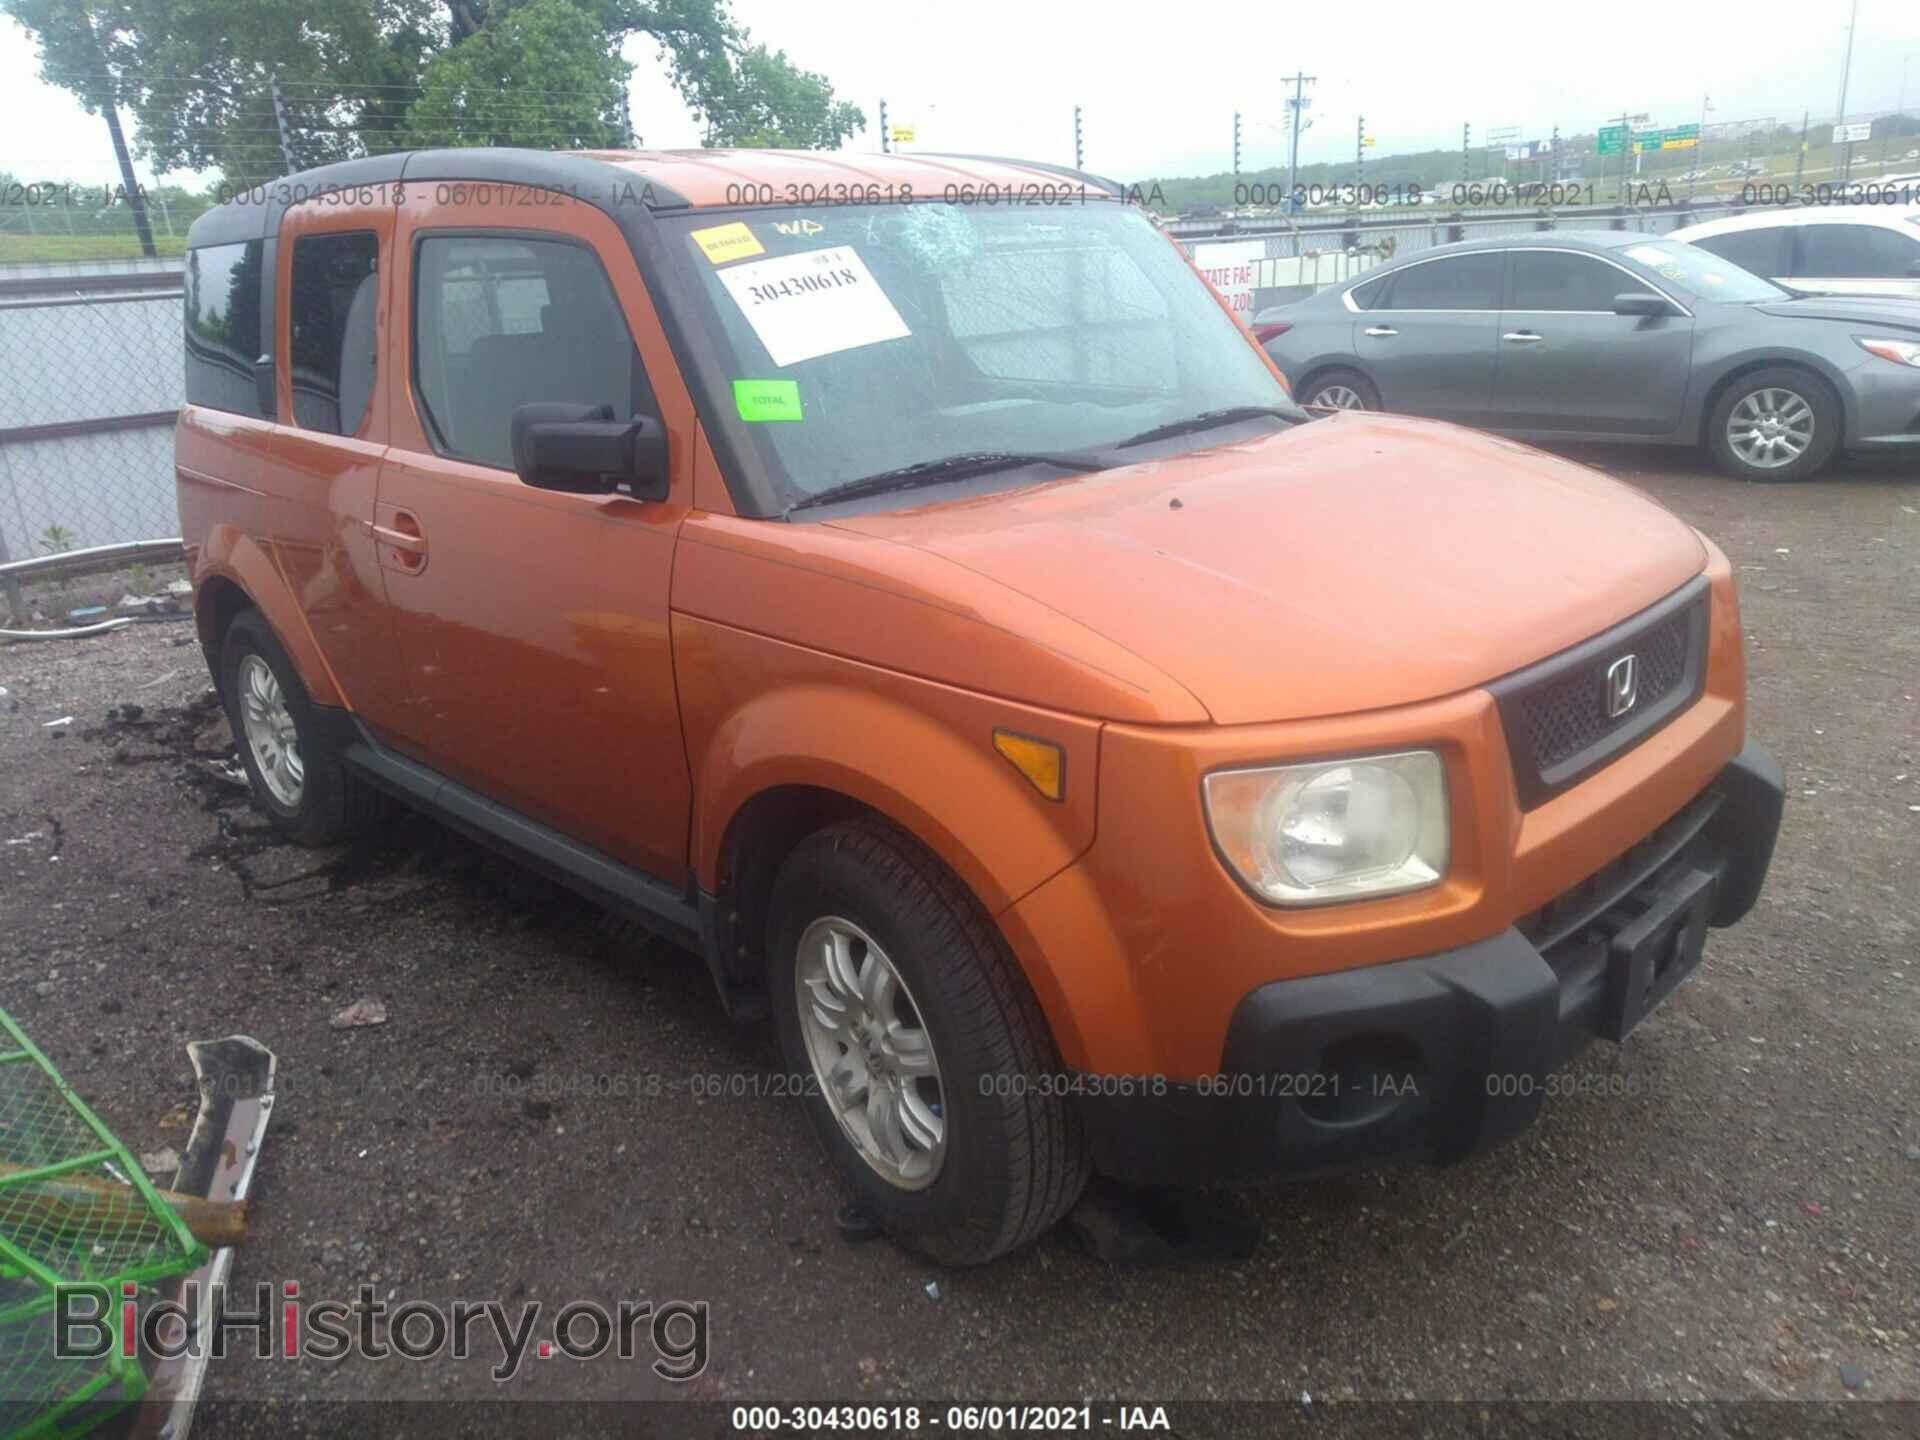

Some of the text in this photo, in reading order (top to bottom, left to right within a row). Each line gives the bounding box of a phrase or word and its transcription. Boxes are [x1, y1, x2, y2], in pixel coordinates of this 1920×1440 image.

[747, 268, 857, 305] 30430618
[1200, 267, 1231, 287] TATE
[751, 395, 785, 406] TOTAL
